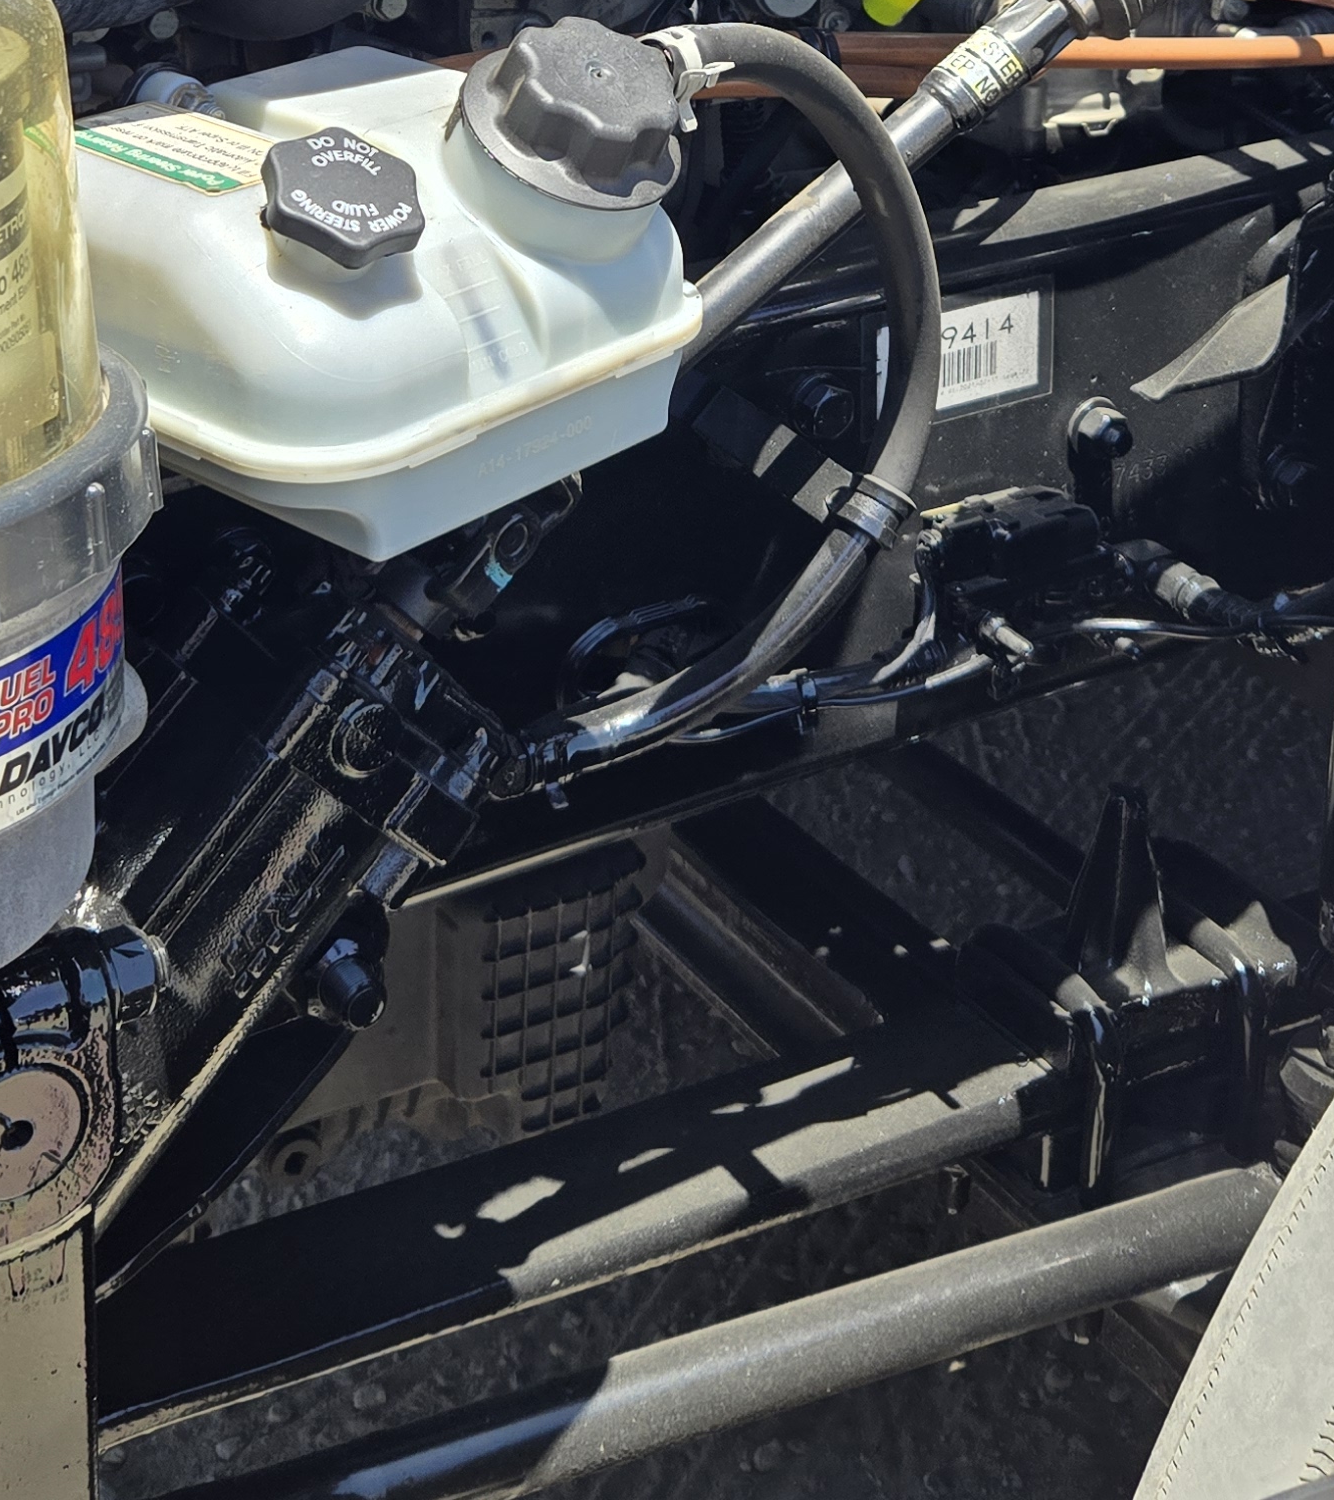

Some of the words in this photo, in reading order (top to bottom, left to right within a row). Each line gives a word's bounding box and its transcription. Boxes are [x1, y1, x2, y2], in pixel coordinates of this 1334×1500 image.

[306, 136, 335, 150] DO
[344, 137, 379, 157] NOT
[125, 148, 181, 172] Steering
[311, 150, 382, 176] OVERFILL
[178, 170, 225, 186] Power
[290, 189, 361, 233] STEERING
[332, 200, 380, 218] FLUID
[368, 202, 413, 233] POWER
